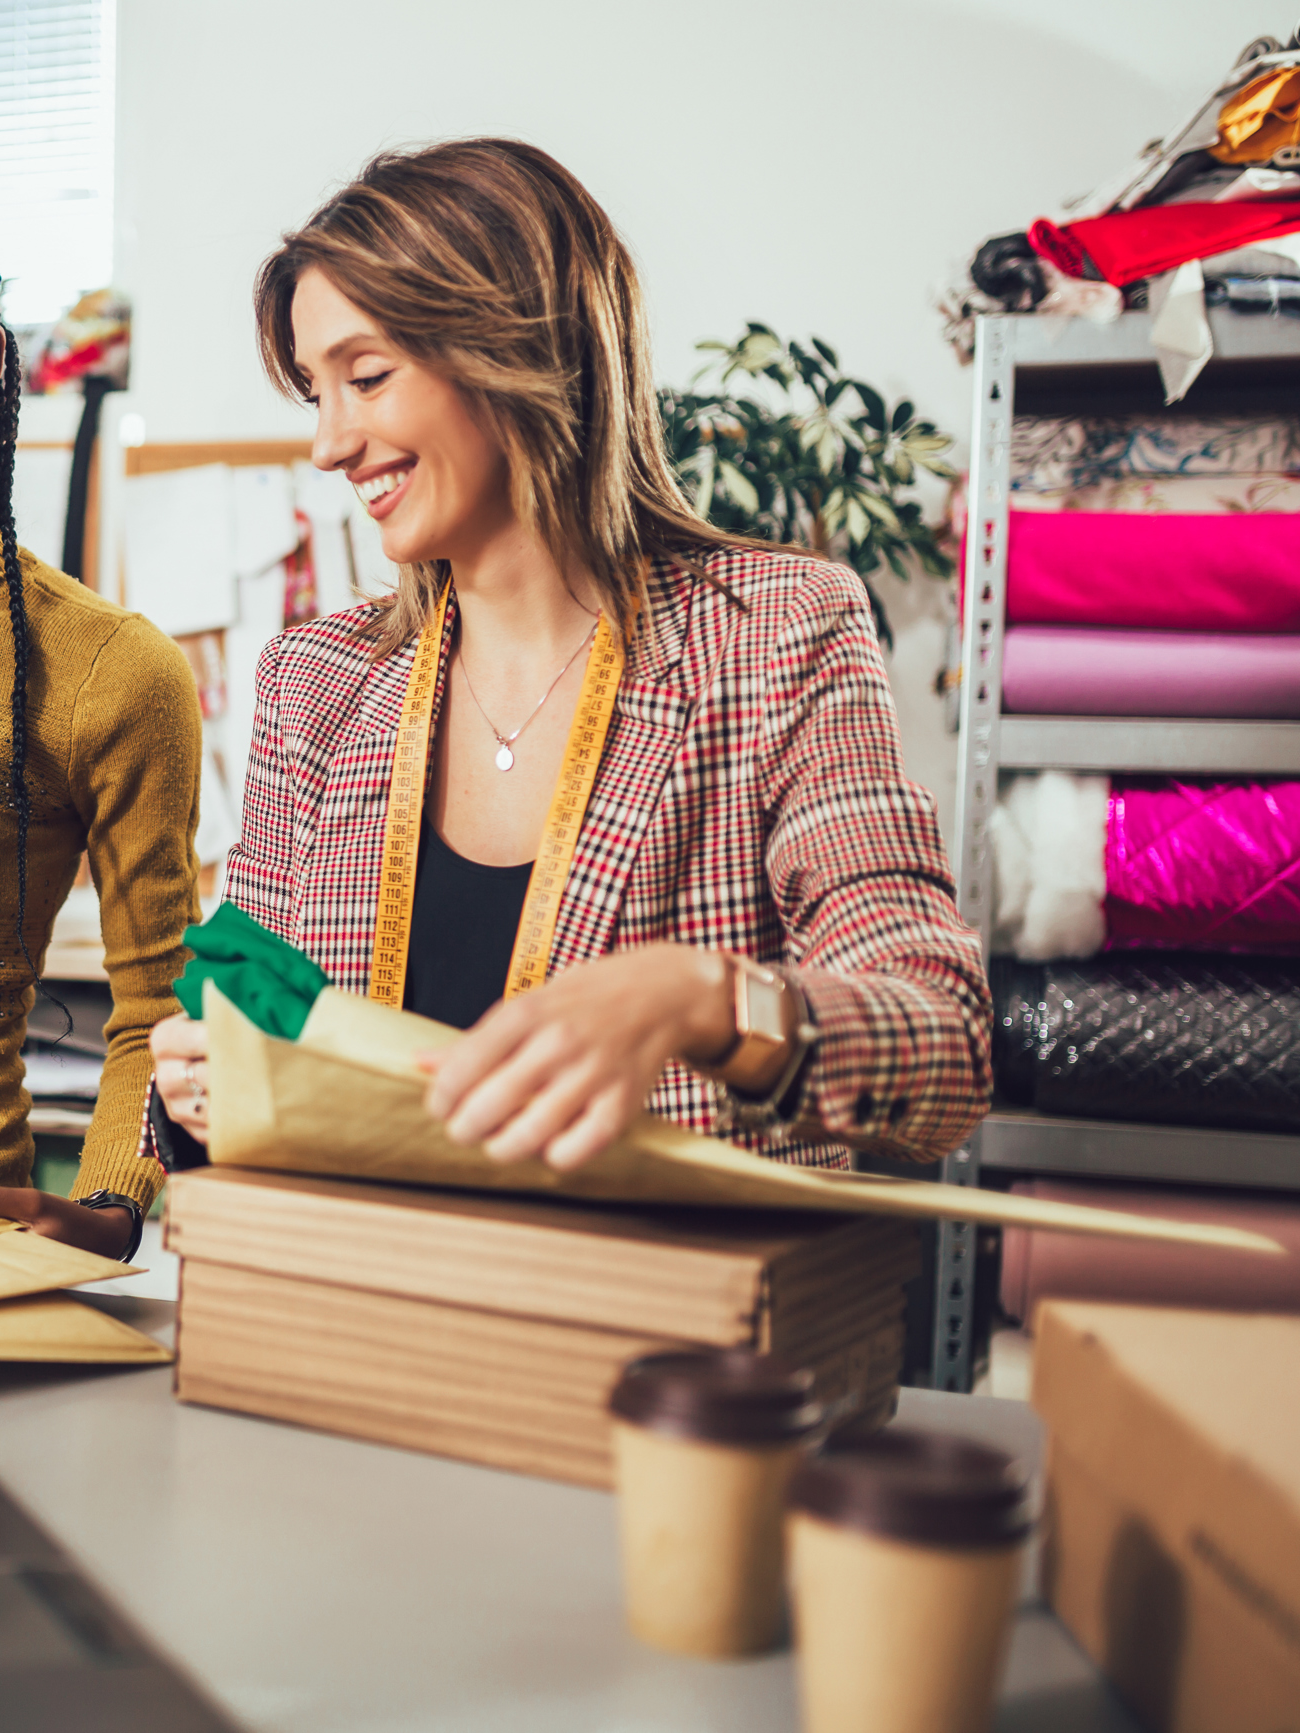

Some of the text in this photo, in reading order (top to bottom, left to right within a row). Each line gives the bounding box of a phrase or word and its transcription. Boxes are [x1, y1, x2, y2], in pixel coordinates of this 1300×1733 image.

[423, 643, 431, 654] 94
[420, 658, 429, 668] 95
[603, 653, 615, 664] 60
[417, 672, 427, 683] 96
[599, 669, 611, 680] 59
[414, 686, 424, 696] 97
[595, 684, 607, 695] 58
[411, 701, 421, 711] 98
[591, 700, 603, 711] 57
[408, 716, 419, 725] 99
[587, 715, 599, 727] 56
[402, 731, 416, 741] 100
[583, 731, 595, 743] 55
[400, 746, 414, 756] 101
[579, 748, 591, 759] 54
[398, 761, 413, 772] 102
[575, 764, 587, 776] 53
[396, 777, 411, 787] 103
[571, 780, 583, 791] 52
[395, 793, 409, 803] 104
[567, 796, 578, 807] 51
[393, 809, 408, 819] 105
[561, 812, 573, 823] 50
[392, 824, 407, 835] 106
[390, 840, 405, 851] 107
[389, 856, 404, 867] 108
[387, 872, 402, 883] 109
[386, 888, 401, 899] 110
[385, 904, 398, 915] 111
[383, 920, 398, 932] 112
[381, 936, 396, 948] 113
[380, 952, 394, 963] 114
[378, 968, 393, 981] 115
[376, 985, 391, 997] 116
